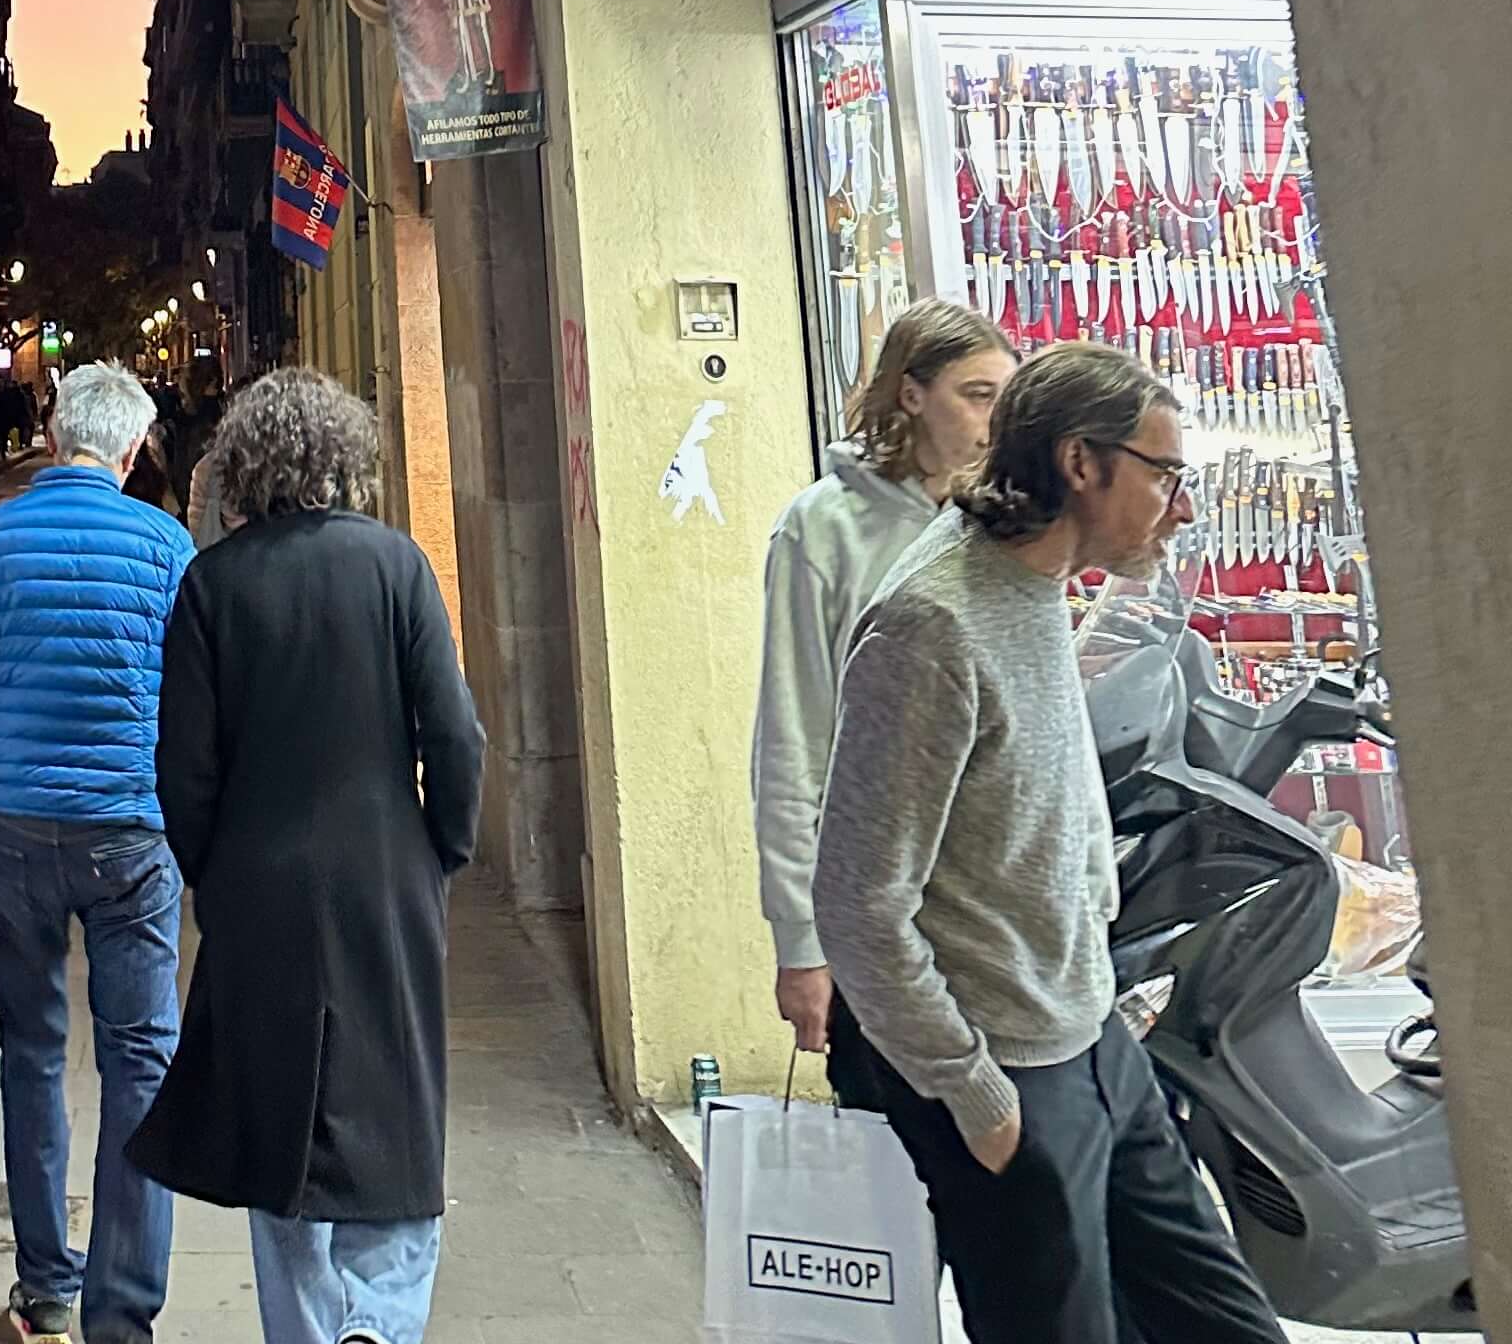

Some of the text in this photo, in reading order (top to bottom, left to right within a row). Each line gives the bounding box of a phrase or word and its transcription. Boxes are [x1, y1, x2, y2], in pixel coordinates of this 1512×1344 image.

[427, 116, 478, 130] AFILAMOS
[479, 113, 500, 126] TODO
[421, 128, 493, 145] HERRAMIENTAS
[761, 1249, 881, 1289] ALE-HOP
